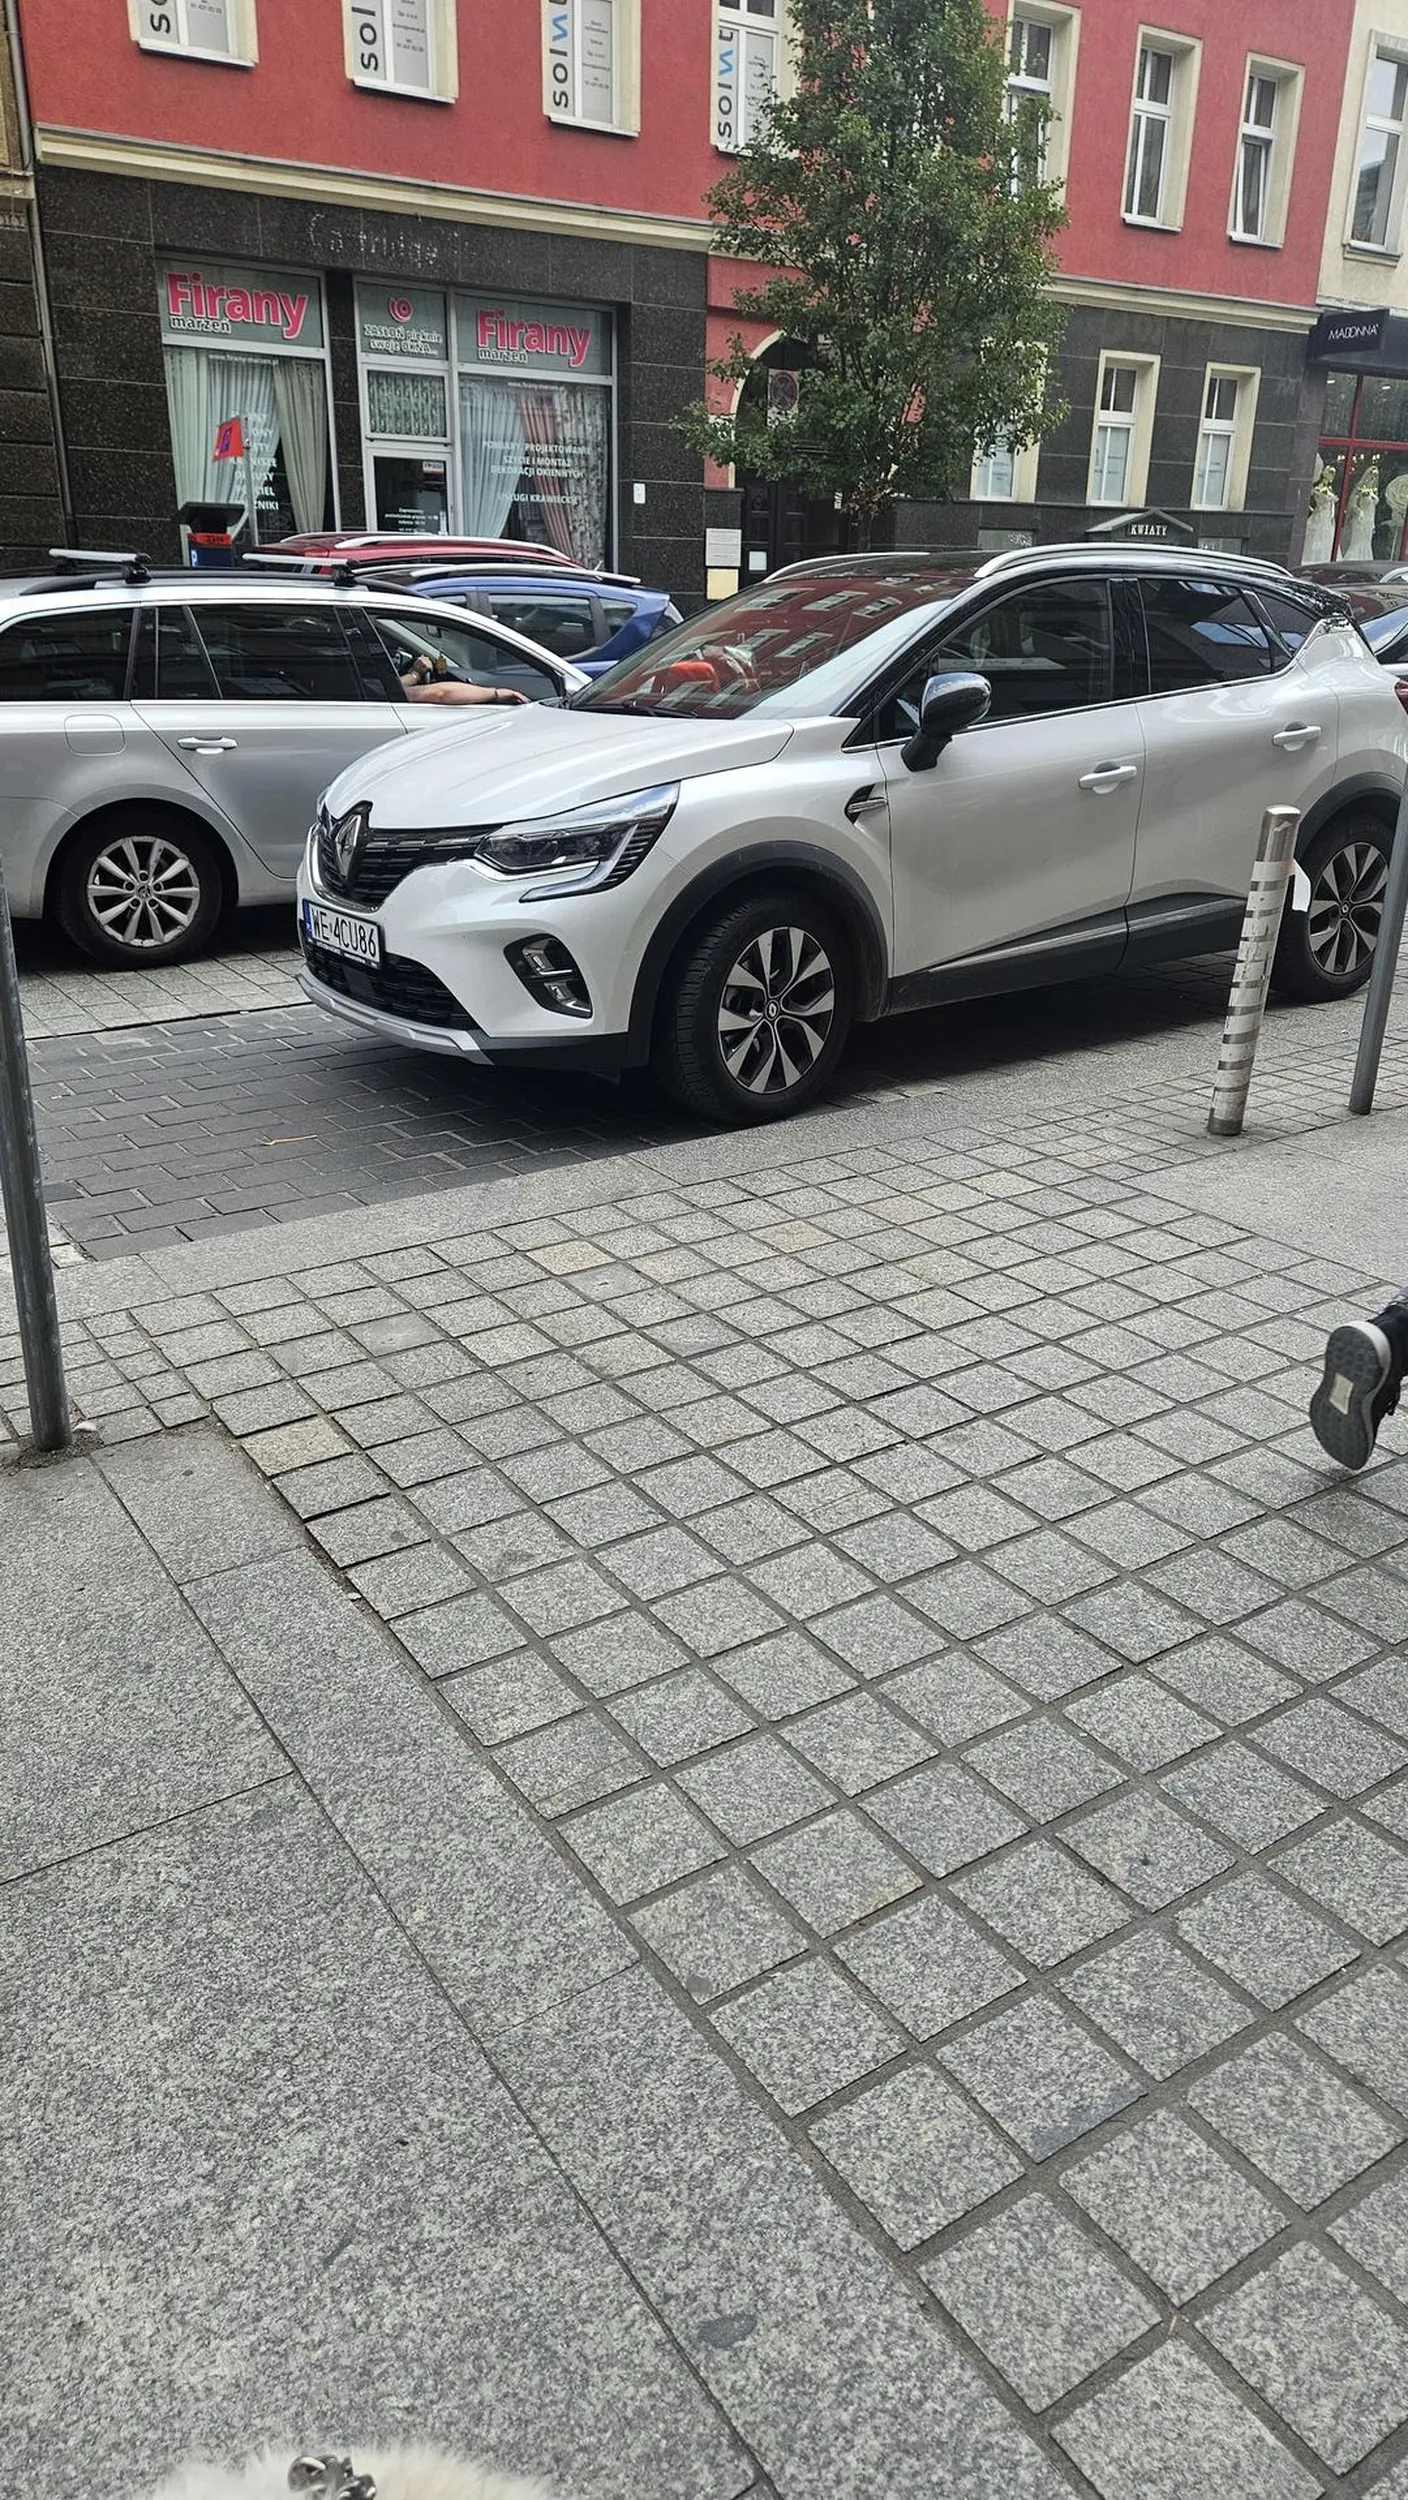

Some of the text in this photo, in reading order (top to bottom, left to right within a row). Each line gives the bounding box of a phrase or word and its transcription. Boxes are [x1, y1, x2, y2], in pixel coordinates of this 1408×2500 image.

[166, 271, 308, 340] Firany
[170, 315, 232, 334] marzeń
[476, 308, 592, 368] Firany
[477, 347, 528, 364] marzeń
[1130, 523, 1168, 537] KWIATY
[334, 917, 377, 958] 4CU86
